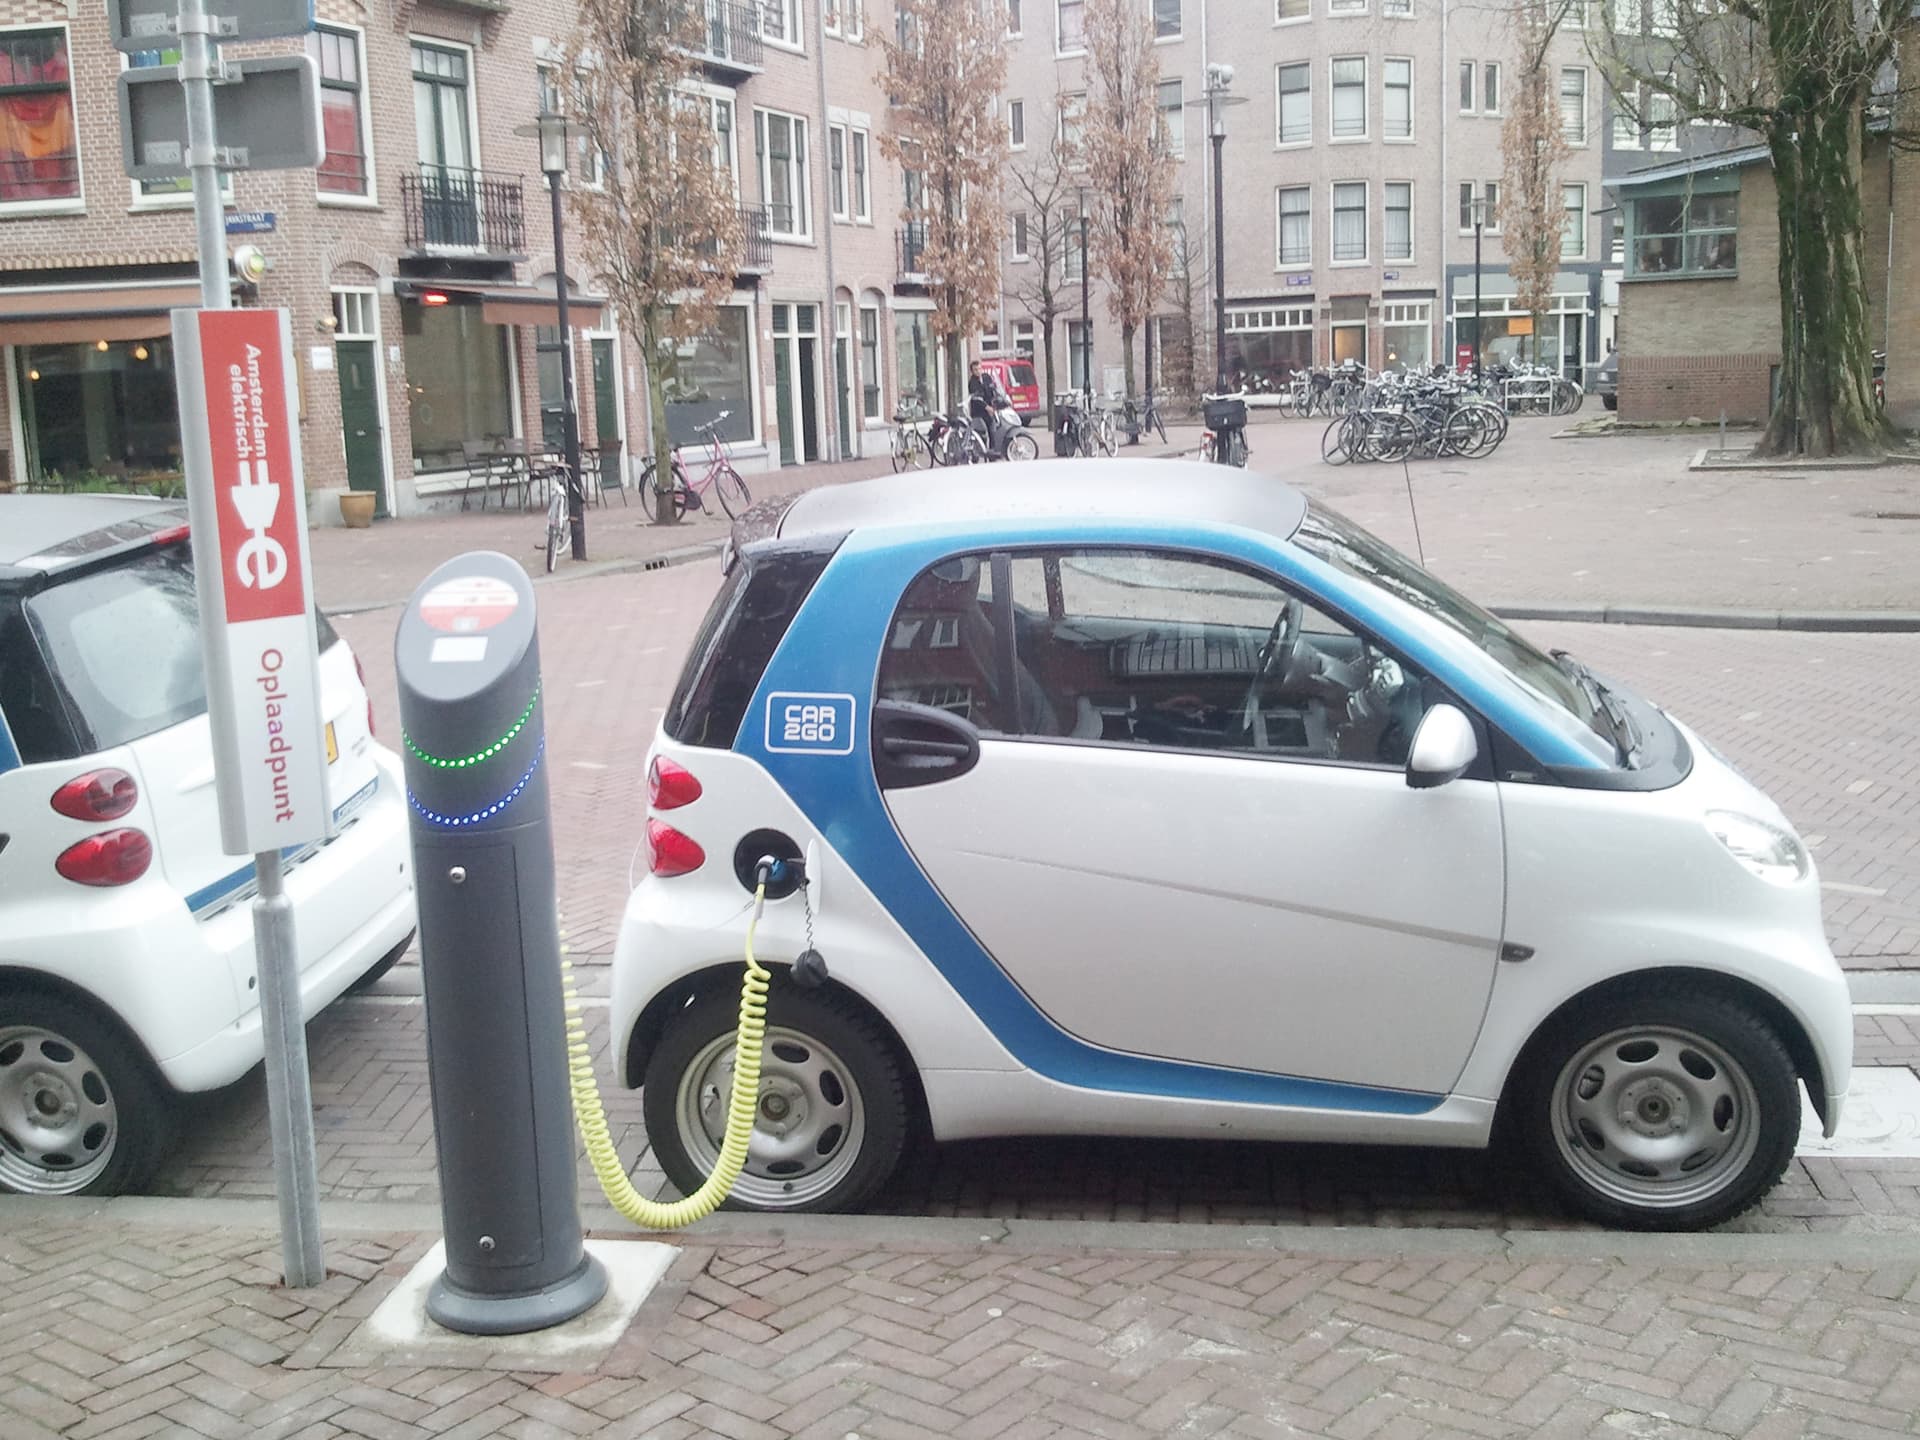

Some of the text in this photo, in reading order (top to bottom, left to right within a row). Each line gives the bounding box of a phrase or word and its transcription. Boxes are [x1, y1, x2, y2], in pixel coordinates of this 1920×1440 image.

[229, 363, 252, 459] elektrisch
[245, 343, 269, 457] Amsterdam
[256, 648, 295, 823] Oplaadpunt
[783, 723, 836, 742] 2GO
[784, 705, 836, 724] CAR
